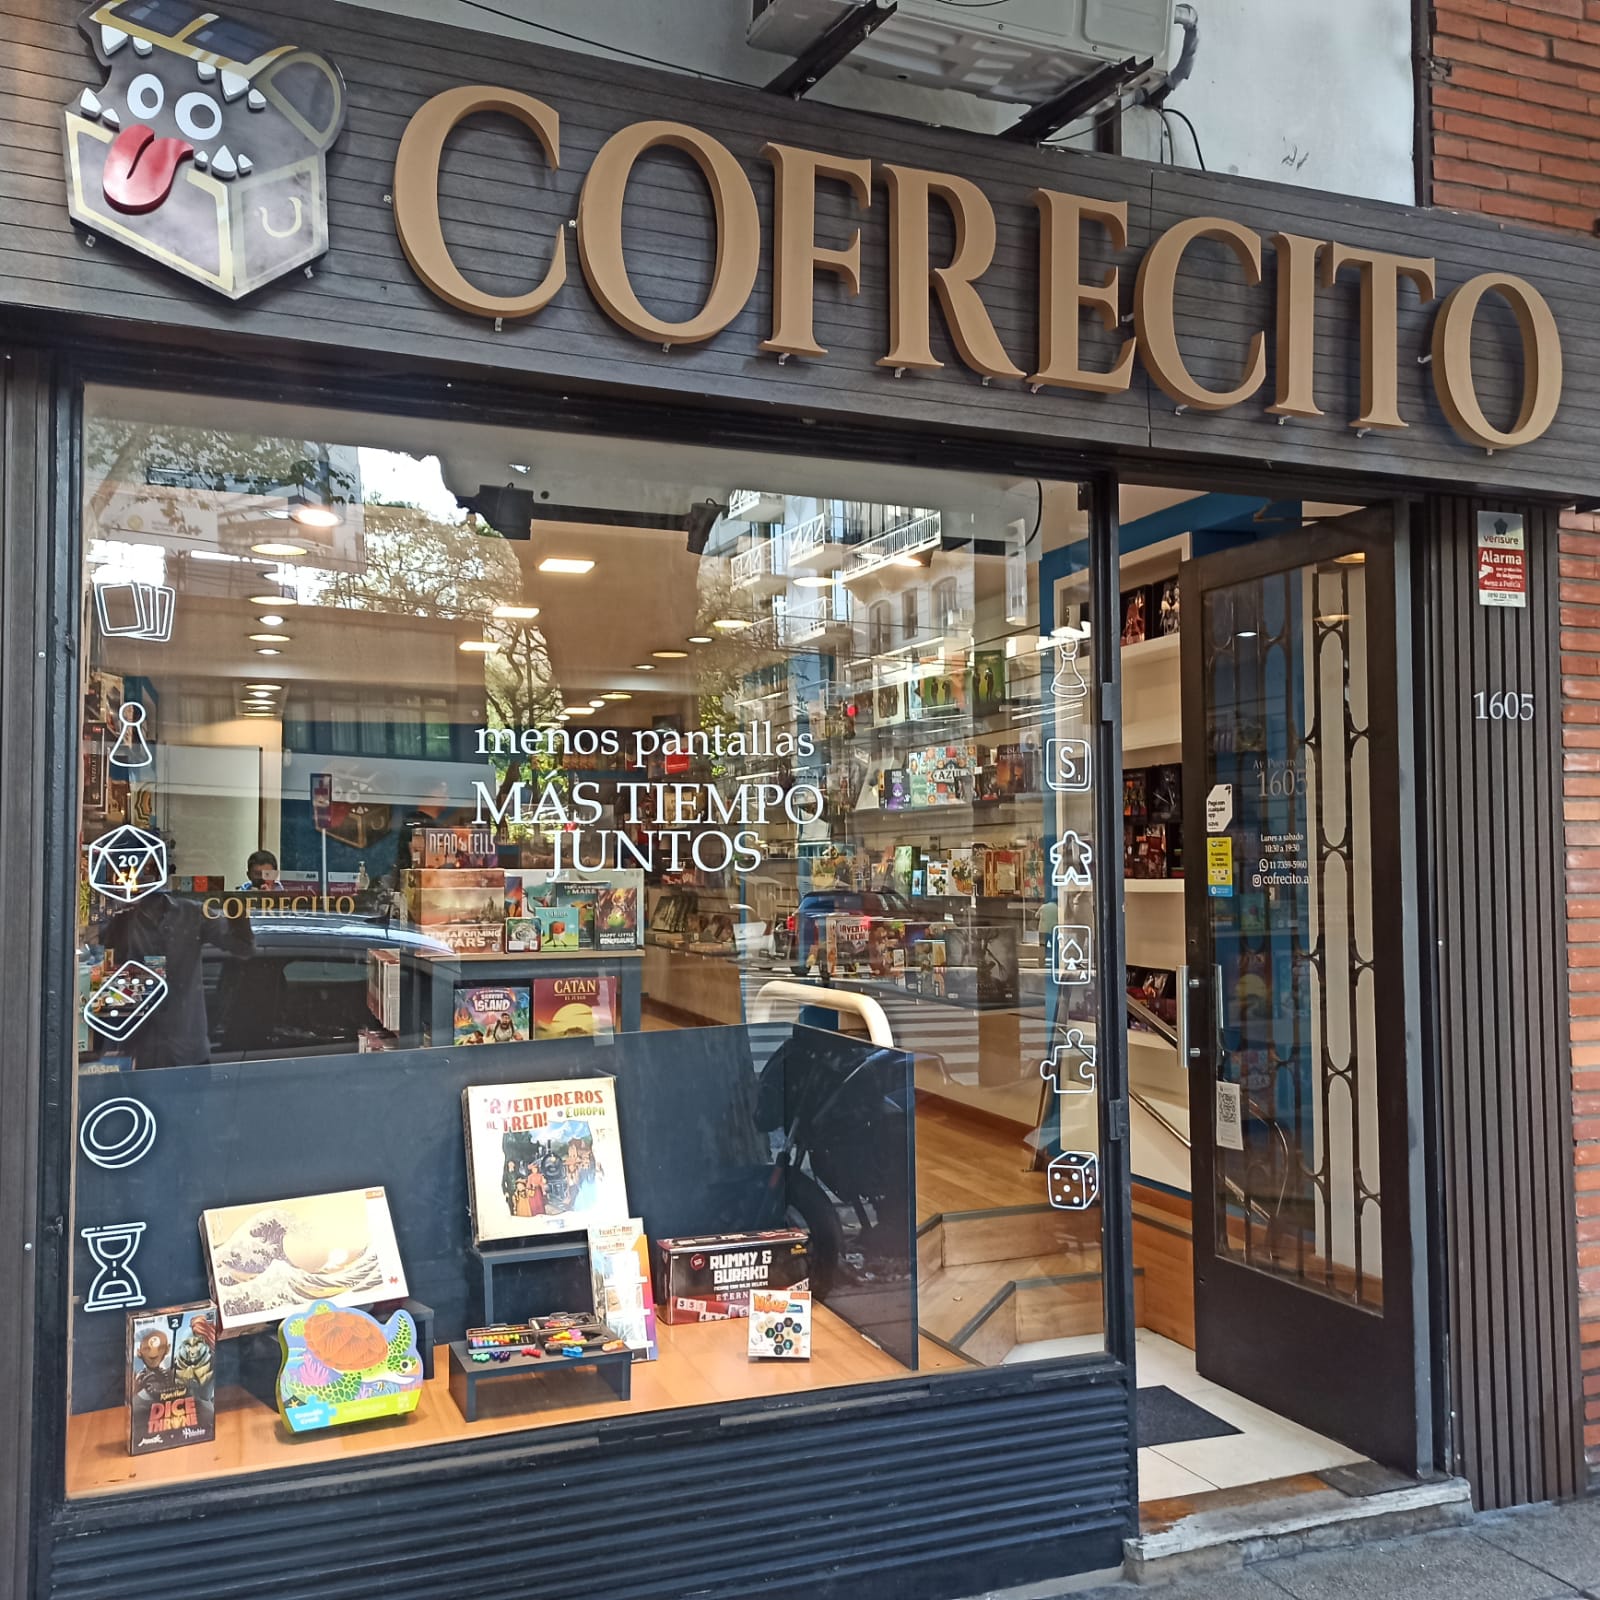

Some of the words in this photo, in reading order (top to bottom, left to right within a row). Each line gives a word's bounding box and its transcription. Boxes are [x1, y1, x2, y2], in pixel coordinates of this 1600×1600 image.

[393, 85, 1564, 449] COFRECITO
[1483, 534, 1519, 545] verisure
[1481, 550, 1522, 565] Alarma
[1473, 691, 1534, 721] 1605
[474, 727, 619, 755] menos
[632, 720, 815, 768] pantallas
[1256, 769, 1308, 797] 1605
[471, 769, 603, 825] MÁS
[616, 781, 824, 825] TIEMPO
[467, 833, 496, 855] CELLS
[118, 854, 139, 868] 20
[546, 829, 763, 883] JUNTOS
[202, 895, 356, 920] COFRECITO
[553, 980, 596, 994] CATAN
[474, 1000, 510, 1011] ISLAND
[709, 1252, 758, 1270] RUMMY
[762, 1250, 772, 1264] &
[713, 1265, 769, 1285] BURAKO
[170, 1318, 179, 1328] 2
[151, 1397, 197, 1421] DICE
[147, 1415, 198, 1434] THRONE
